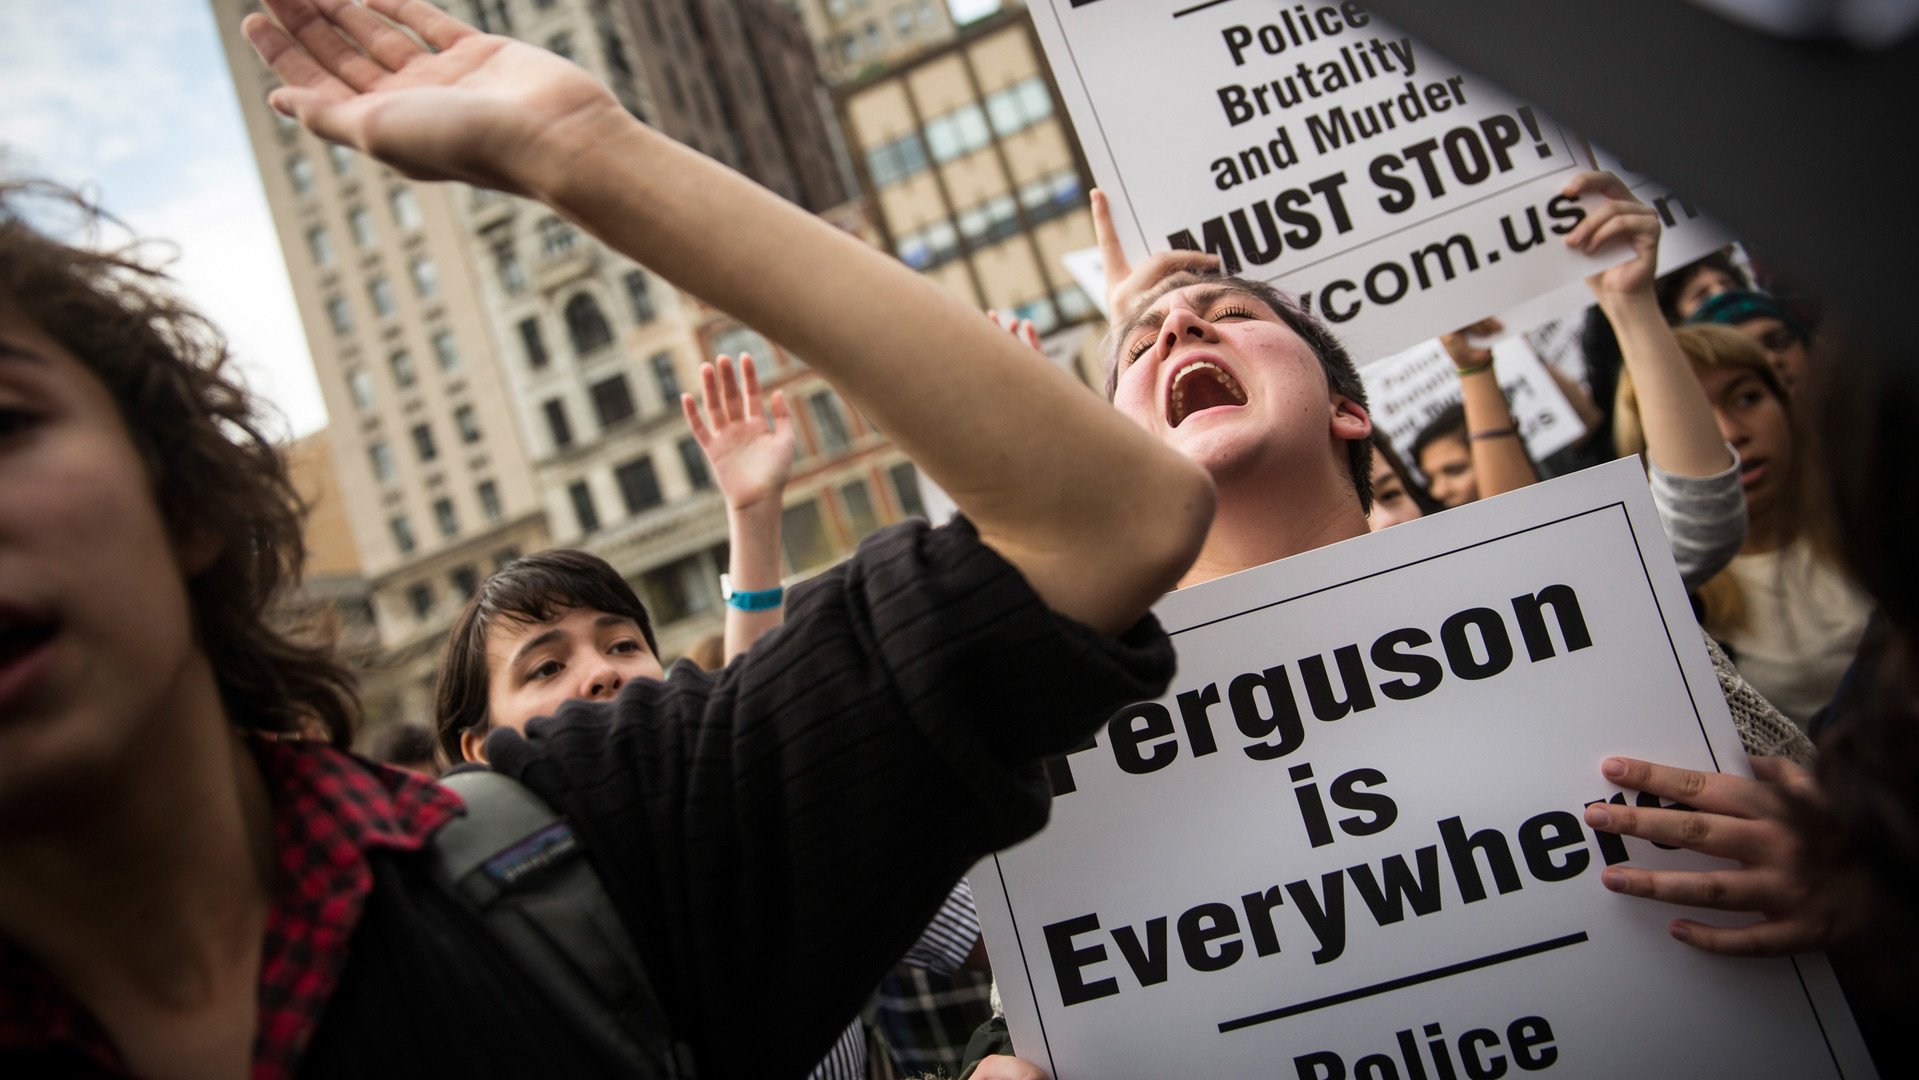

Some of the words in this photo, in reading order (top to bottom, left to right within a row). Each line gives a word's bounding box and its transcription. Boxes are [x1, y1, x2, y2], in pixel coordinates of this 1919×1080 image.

[1222, 0, 1370, 66] Police
[1217, 38, 1416, 127] Brutality
[1210, 126, 1299, 191] and
[1305, 75, 1467, 155] Murder
[1166, 171, 1354, 276] MUST
[1369, 105, 1552, 215] STOP!
[1287, 762, 1399, 849] is
